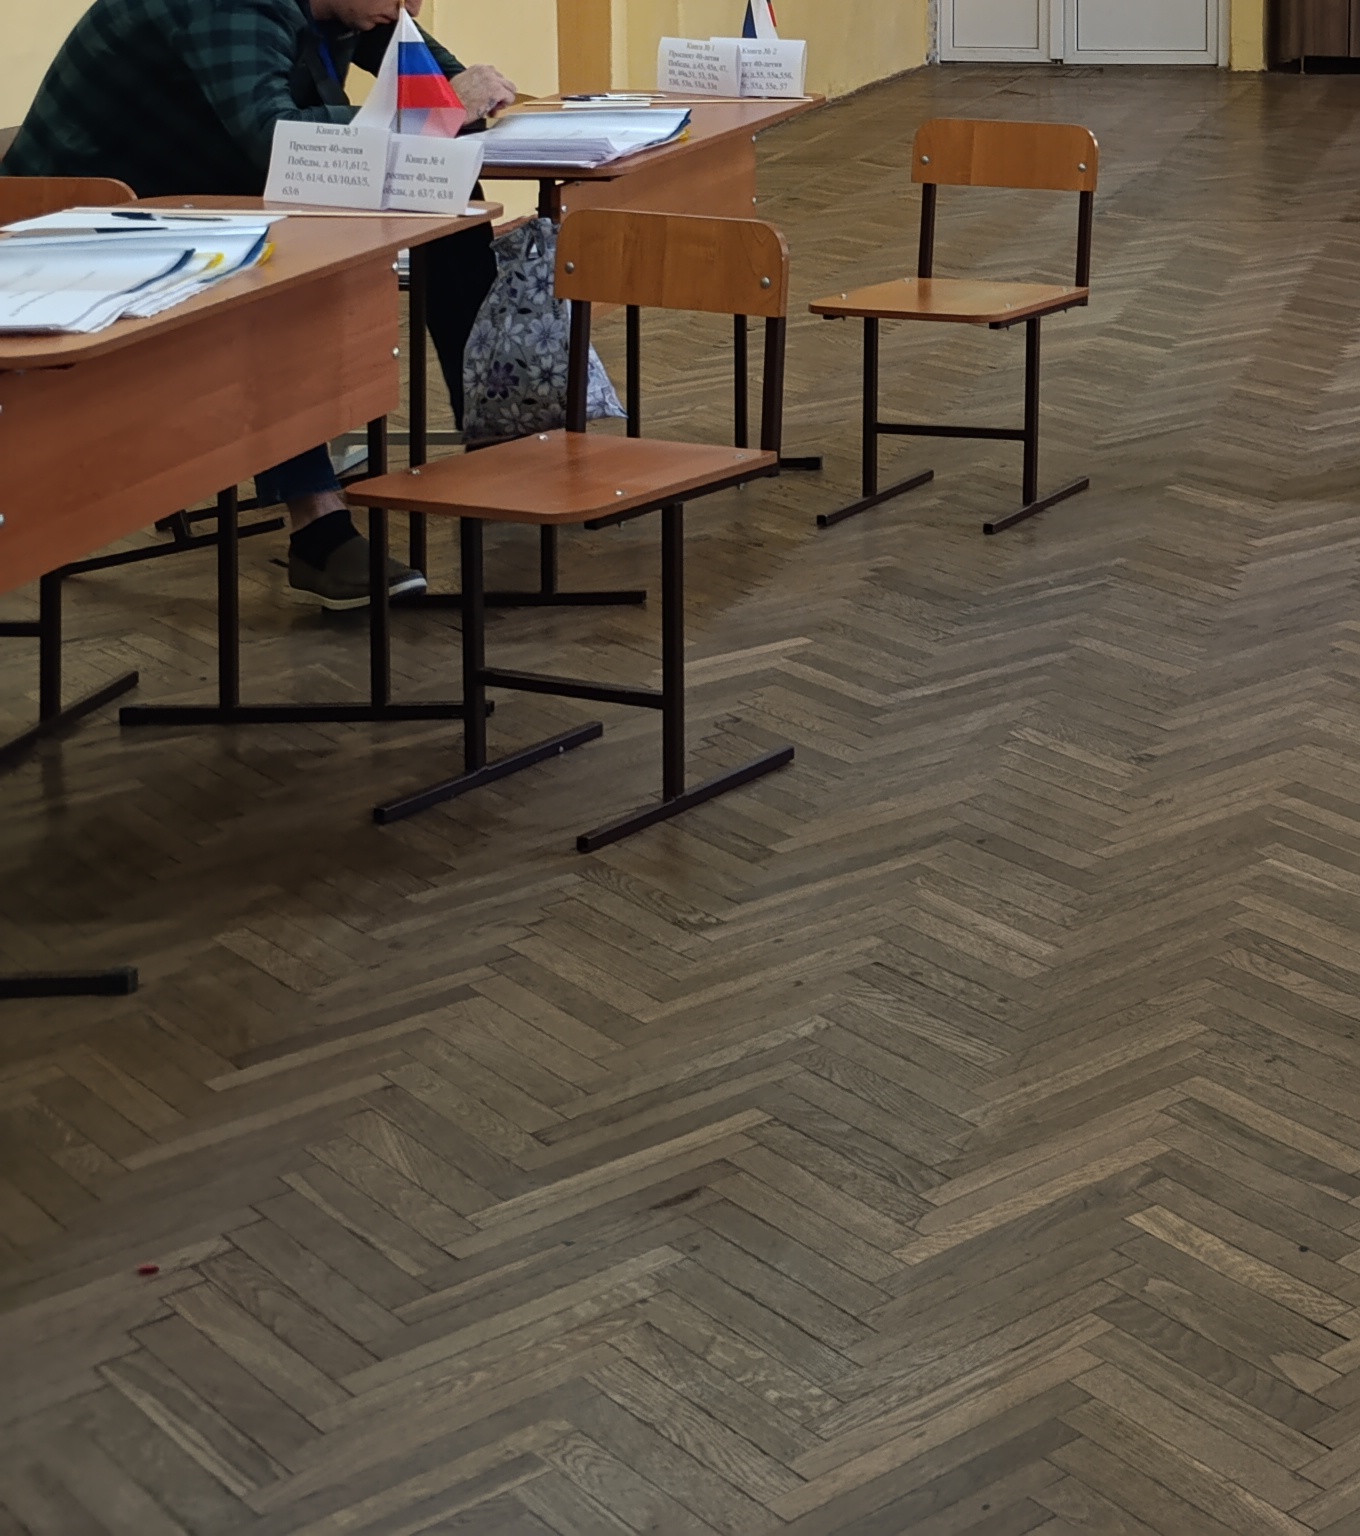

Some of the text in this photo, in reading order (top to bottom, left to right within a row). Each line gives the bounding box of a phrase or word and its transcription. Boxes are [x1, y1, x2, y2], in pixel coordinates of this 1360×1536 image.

[316, 126, 340, 135] Книга
[341, 127, 351, 136] №
[289, 141, 364, 155] Проспект 40-летия
[405, 154, 428, 164] Книга
[385, 172, 448, 183] роспект 40-летия
